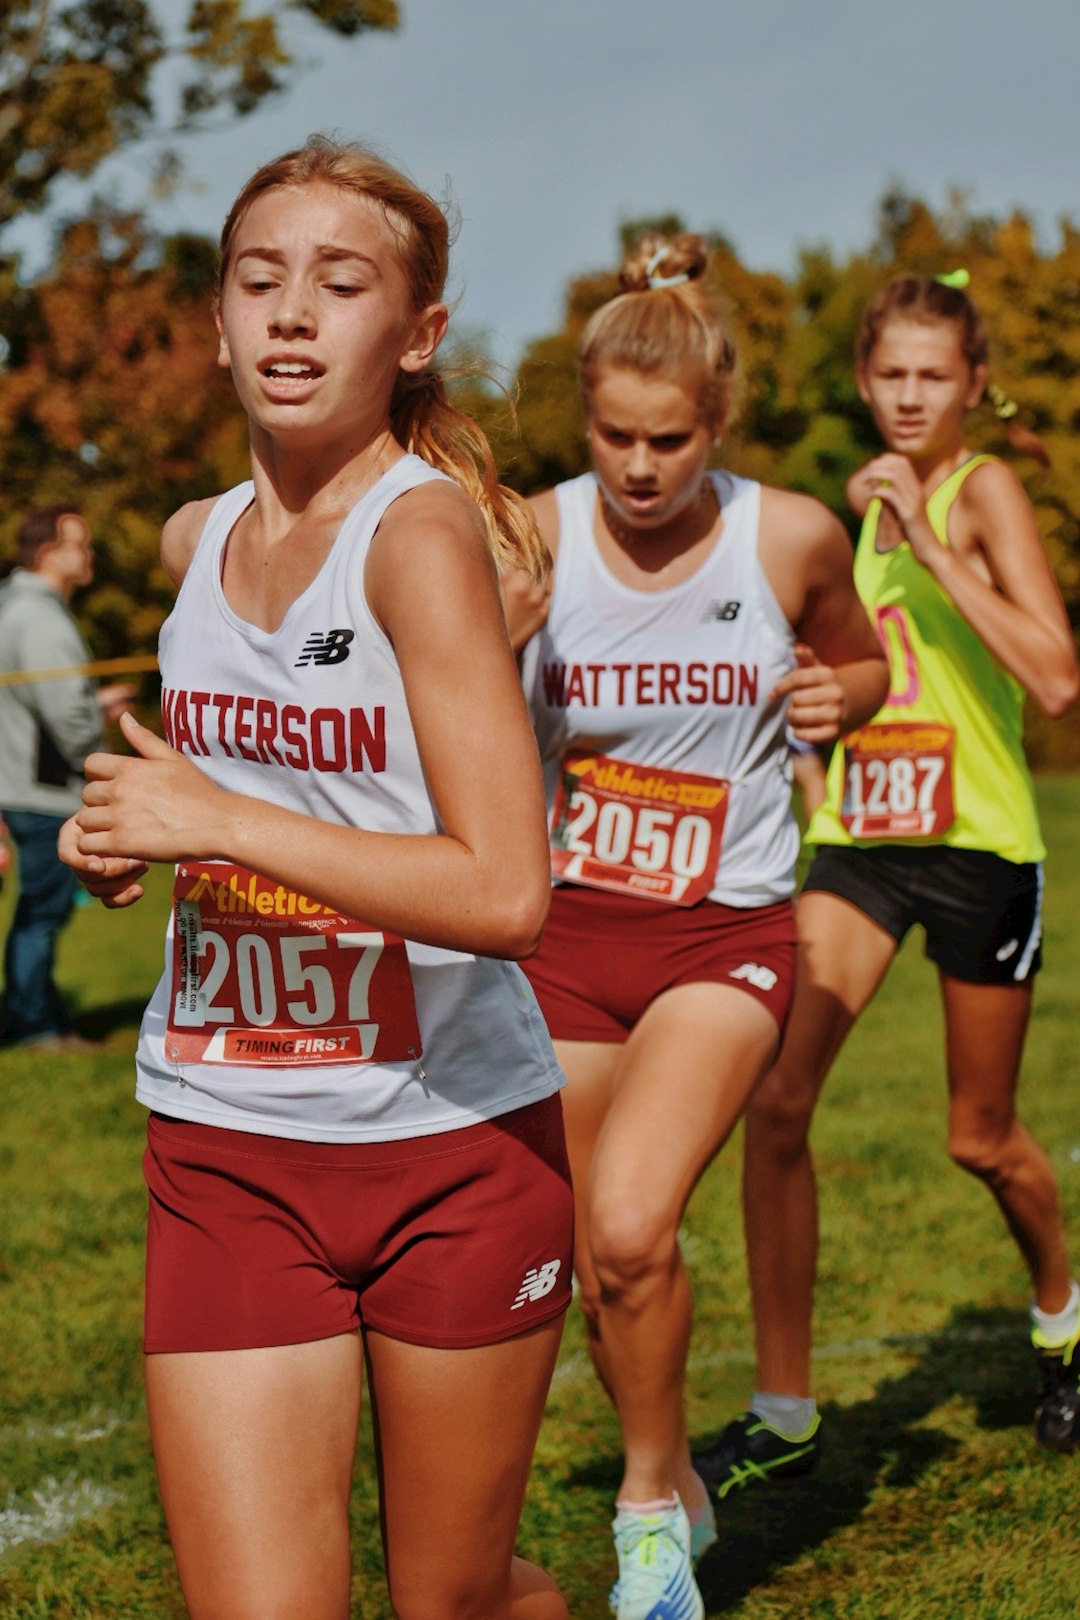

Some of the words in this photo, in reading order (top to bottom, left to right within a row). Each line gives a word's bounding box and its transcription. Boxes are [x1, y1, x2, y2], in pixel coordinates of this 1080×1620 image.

[542, 662, 758, 708] WATTERSON
[848, 756, 945, 816] 1287
[563, 791, 712, 879] 2050
[195, 930, 385, 1027] 2057
